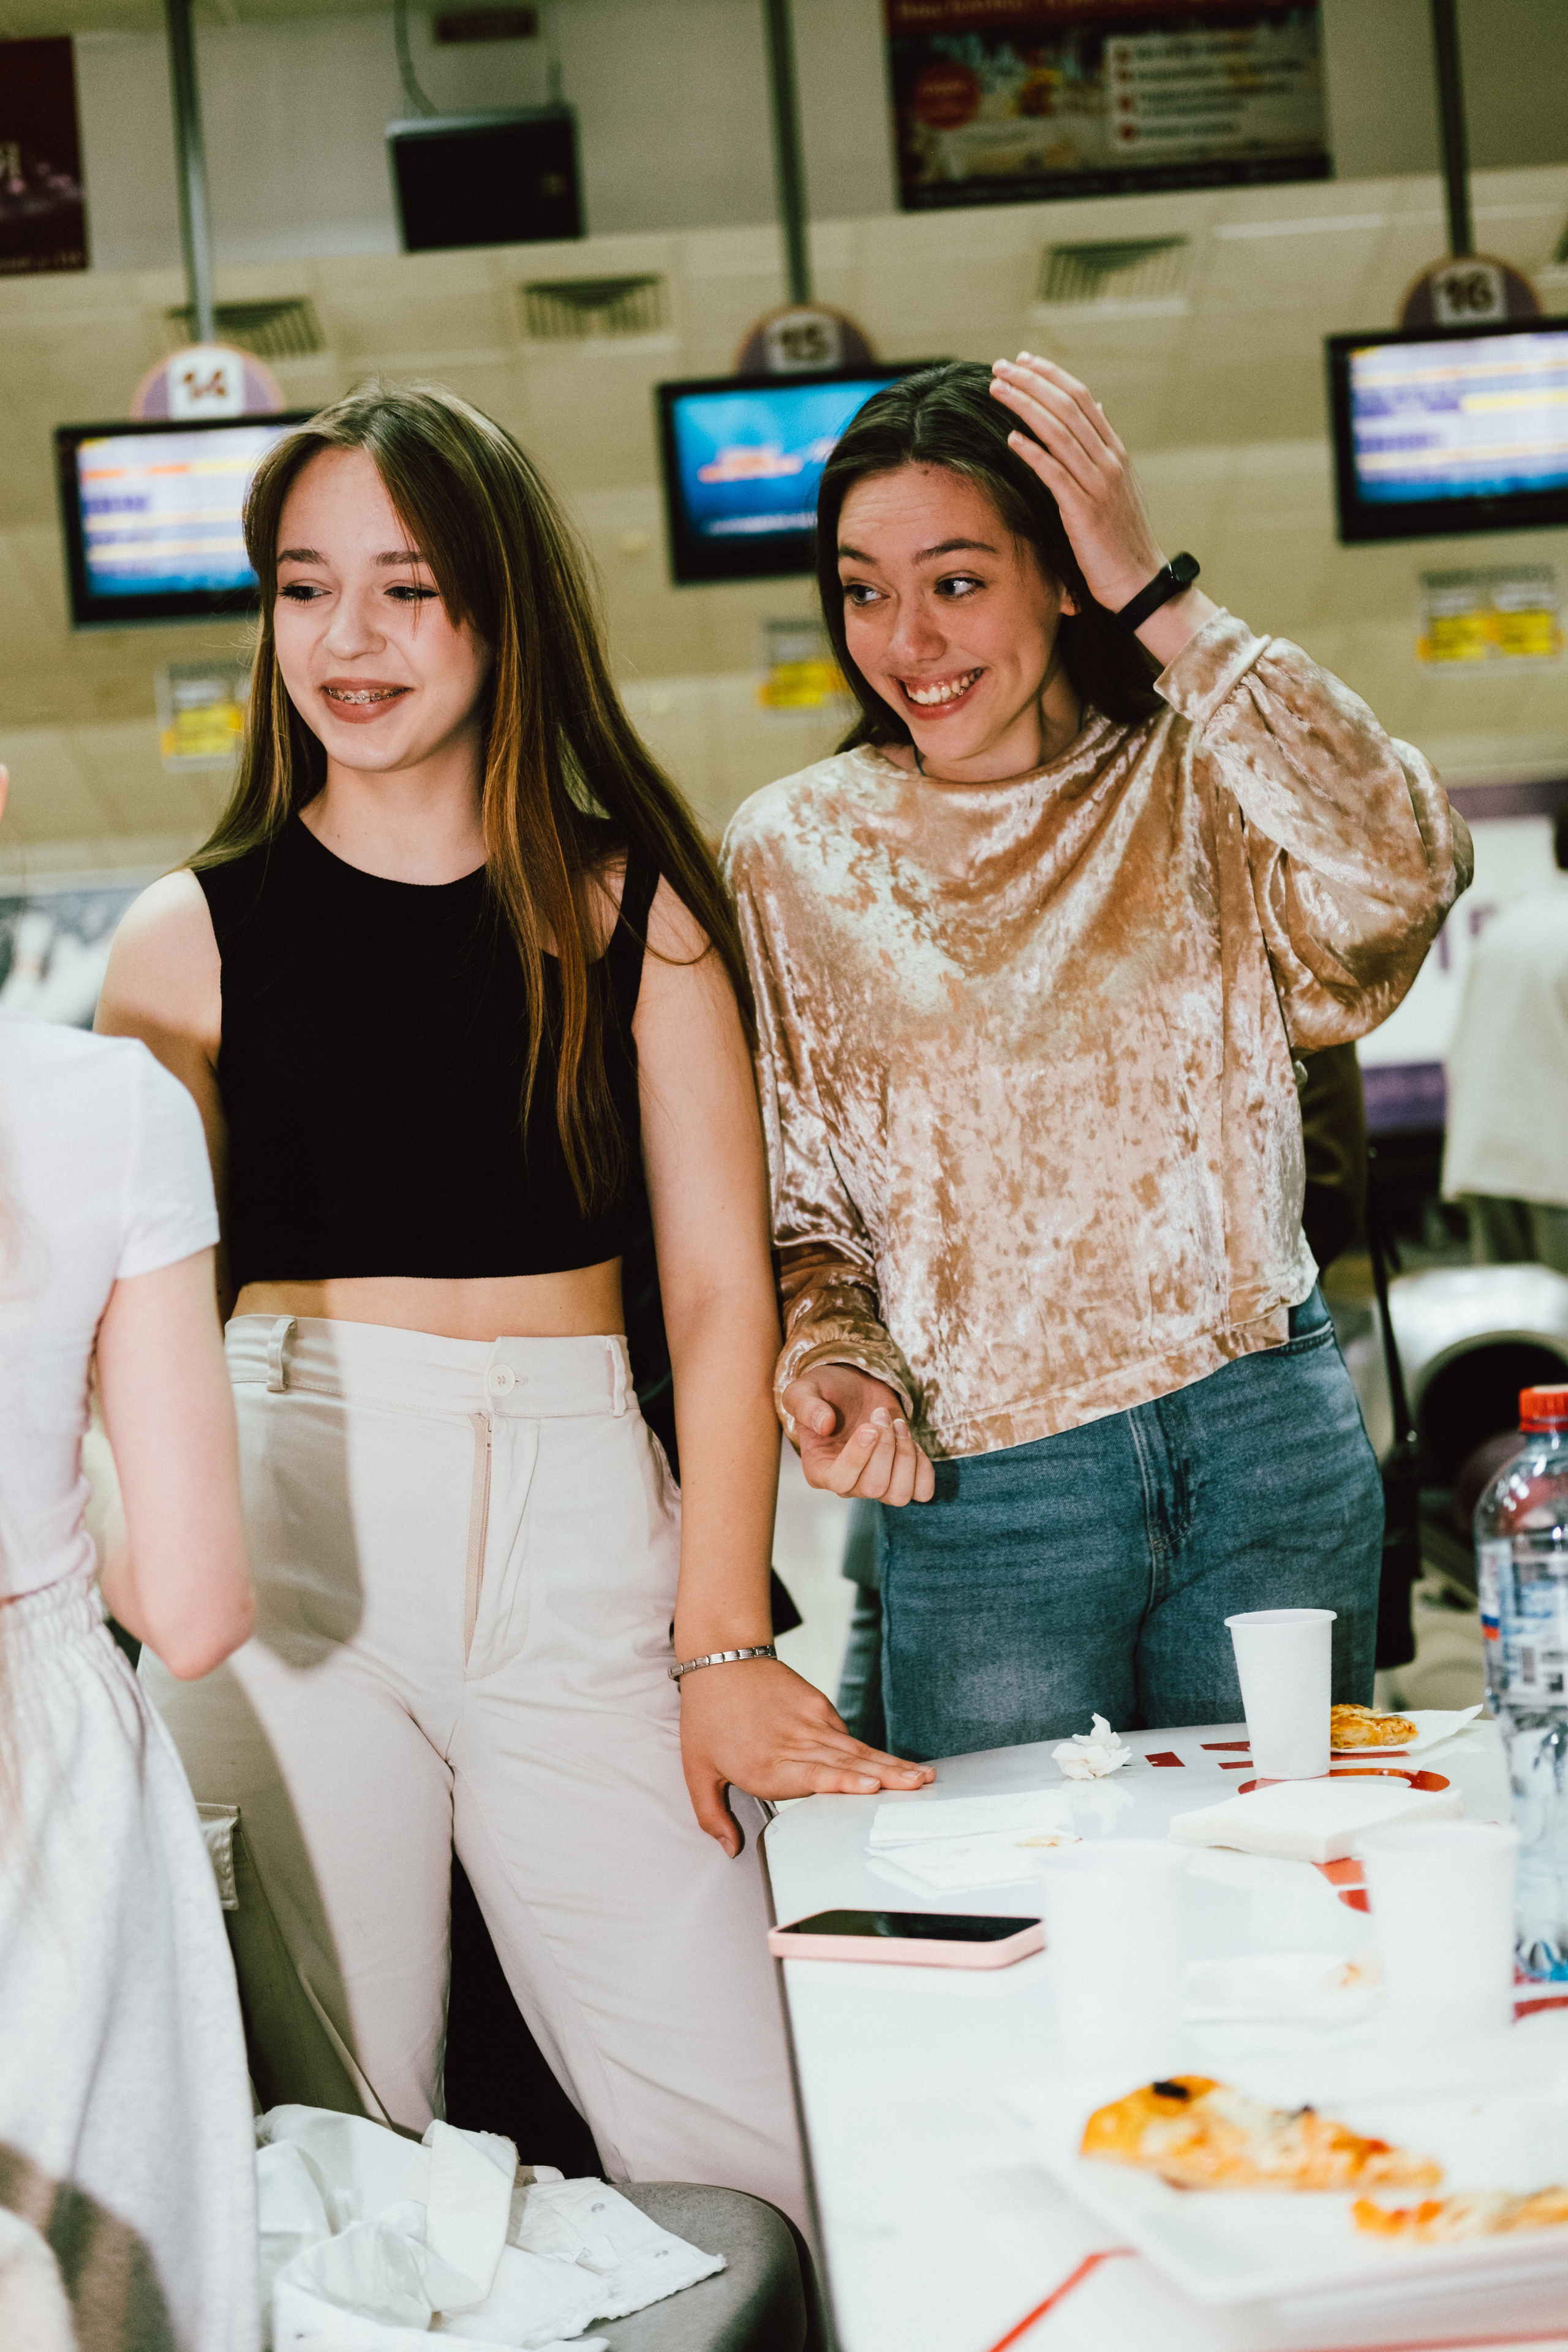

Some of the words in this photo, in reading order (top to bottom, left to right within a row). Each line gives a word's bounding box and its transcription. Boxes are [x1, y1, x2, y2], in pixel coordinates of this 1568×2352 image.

[1446, 271, 1493, 312] 16
[780, 323, 828, 360] 15
[183, 370, 226, 399] 14
